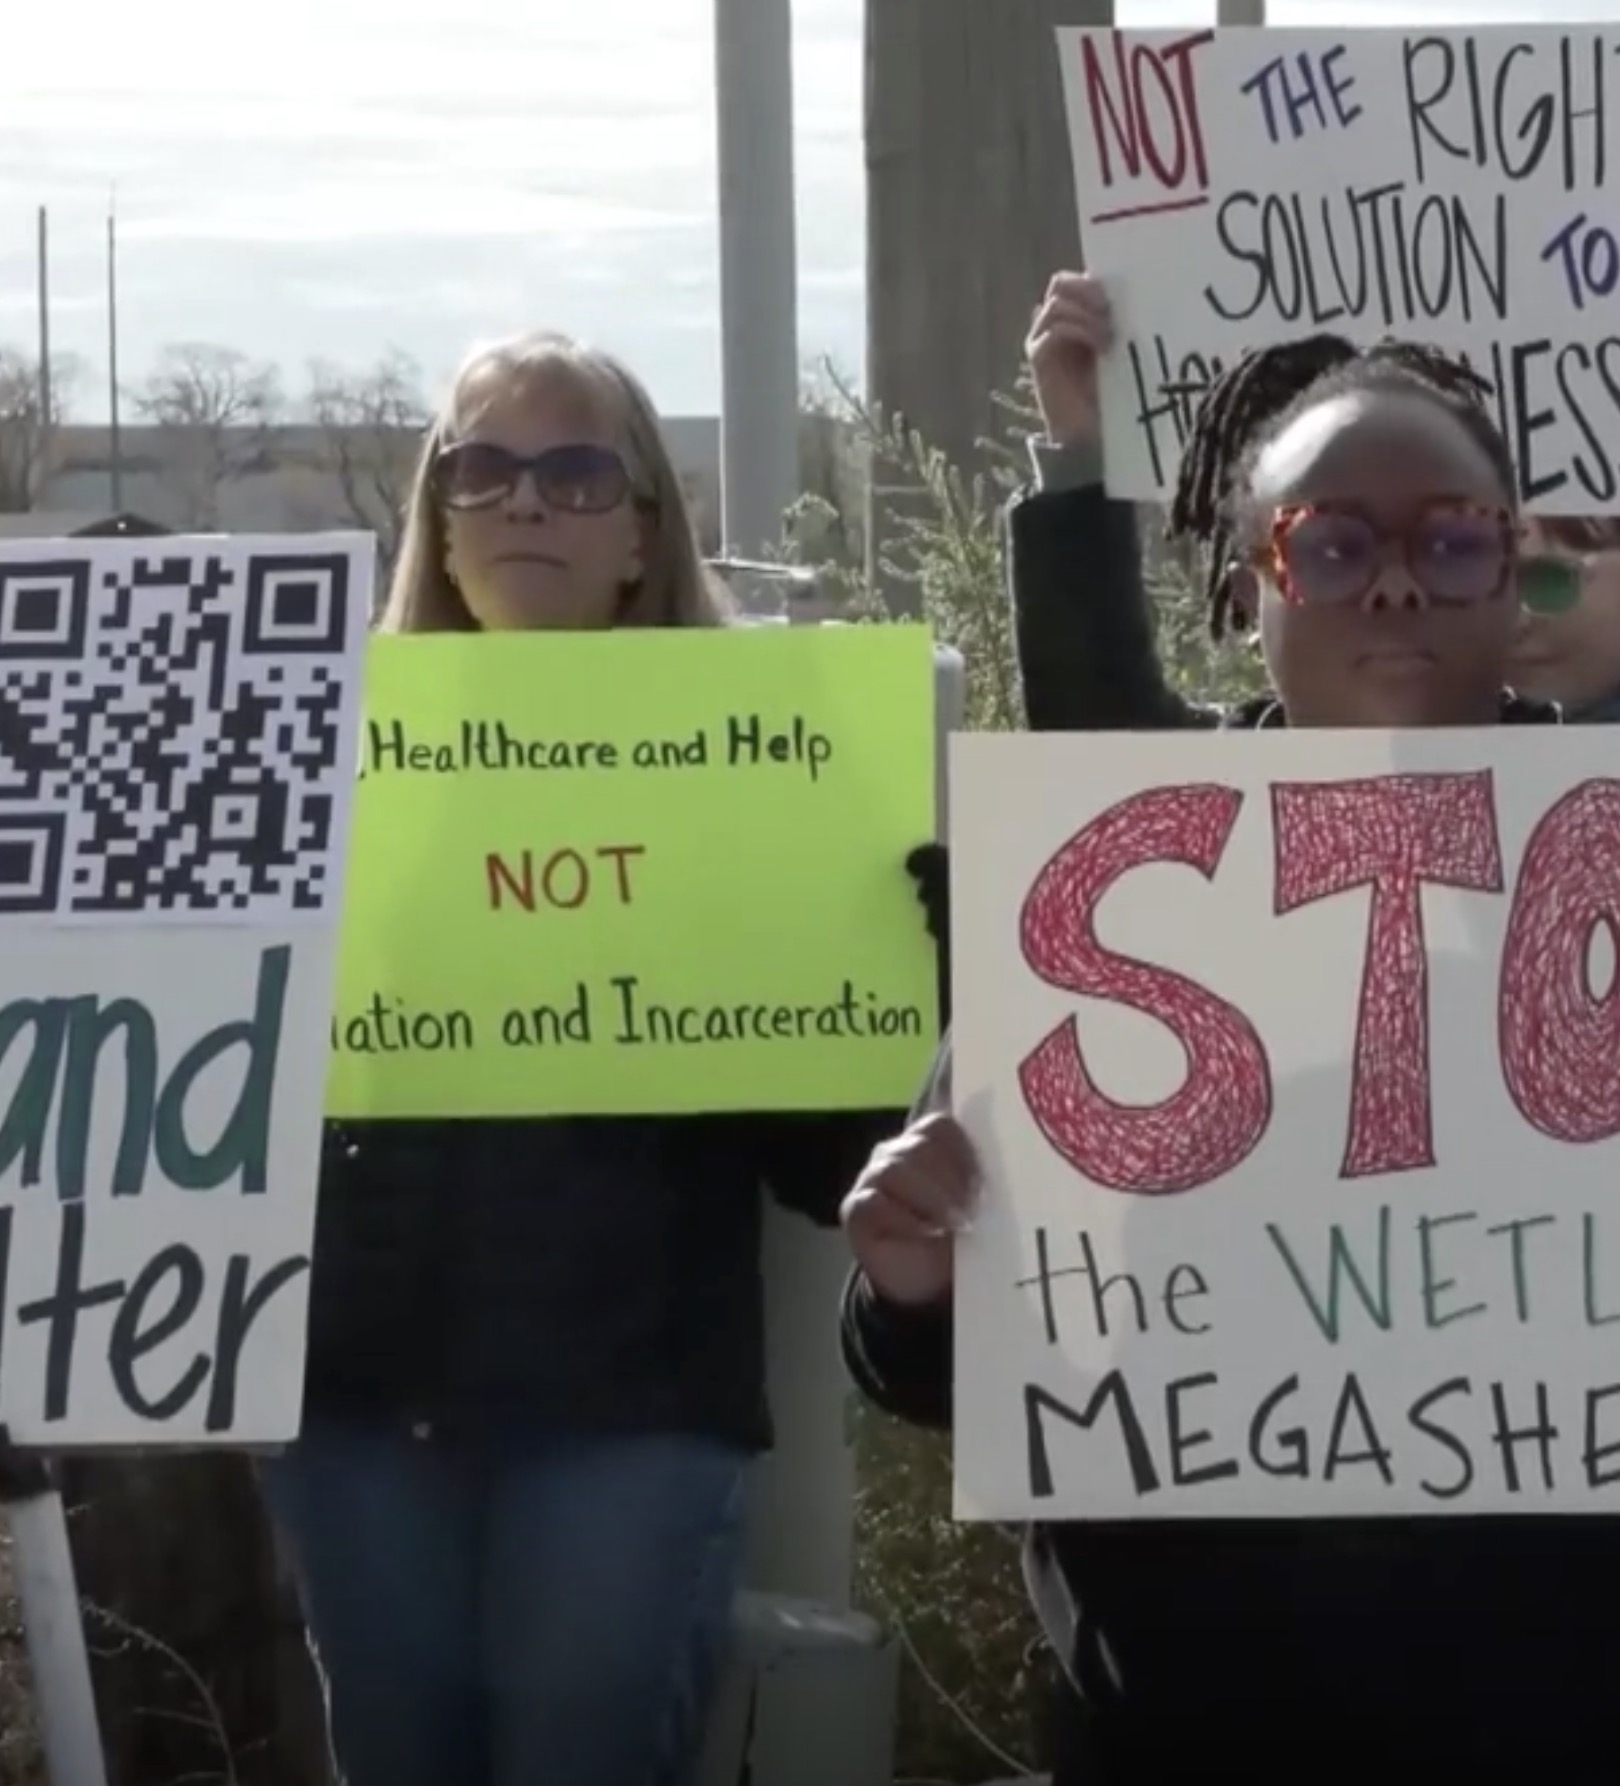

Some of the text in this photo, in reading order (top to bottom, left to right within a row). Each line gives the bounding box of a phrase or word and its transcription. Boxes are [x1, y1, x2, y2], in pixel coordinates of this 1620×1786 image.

[1081, 29, 1215, 189] NOT
[1240, 44, 1363, 144] THE
[1203, 182, 1620, 325] SOLUTION TO
[368, 716, 832, 781] Healthcare and Help
[485, 845, 646, 912] NOT
[331, 975, 923, 1054] ation and Incarceration
[1014, 1226, 1212, 1343] the
